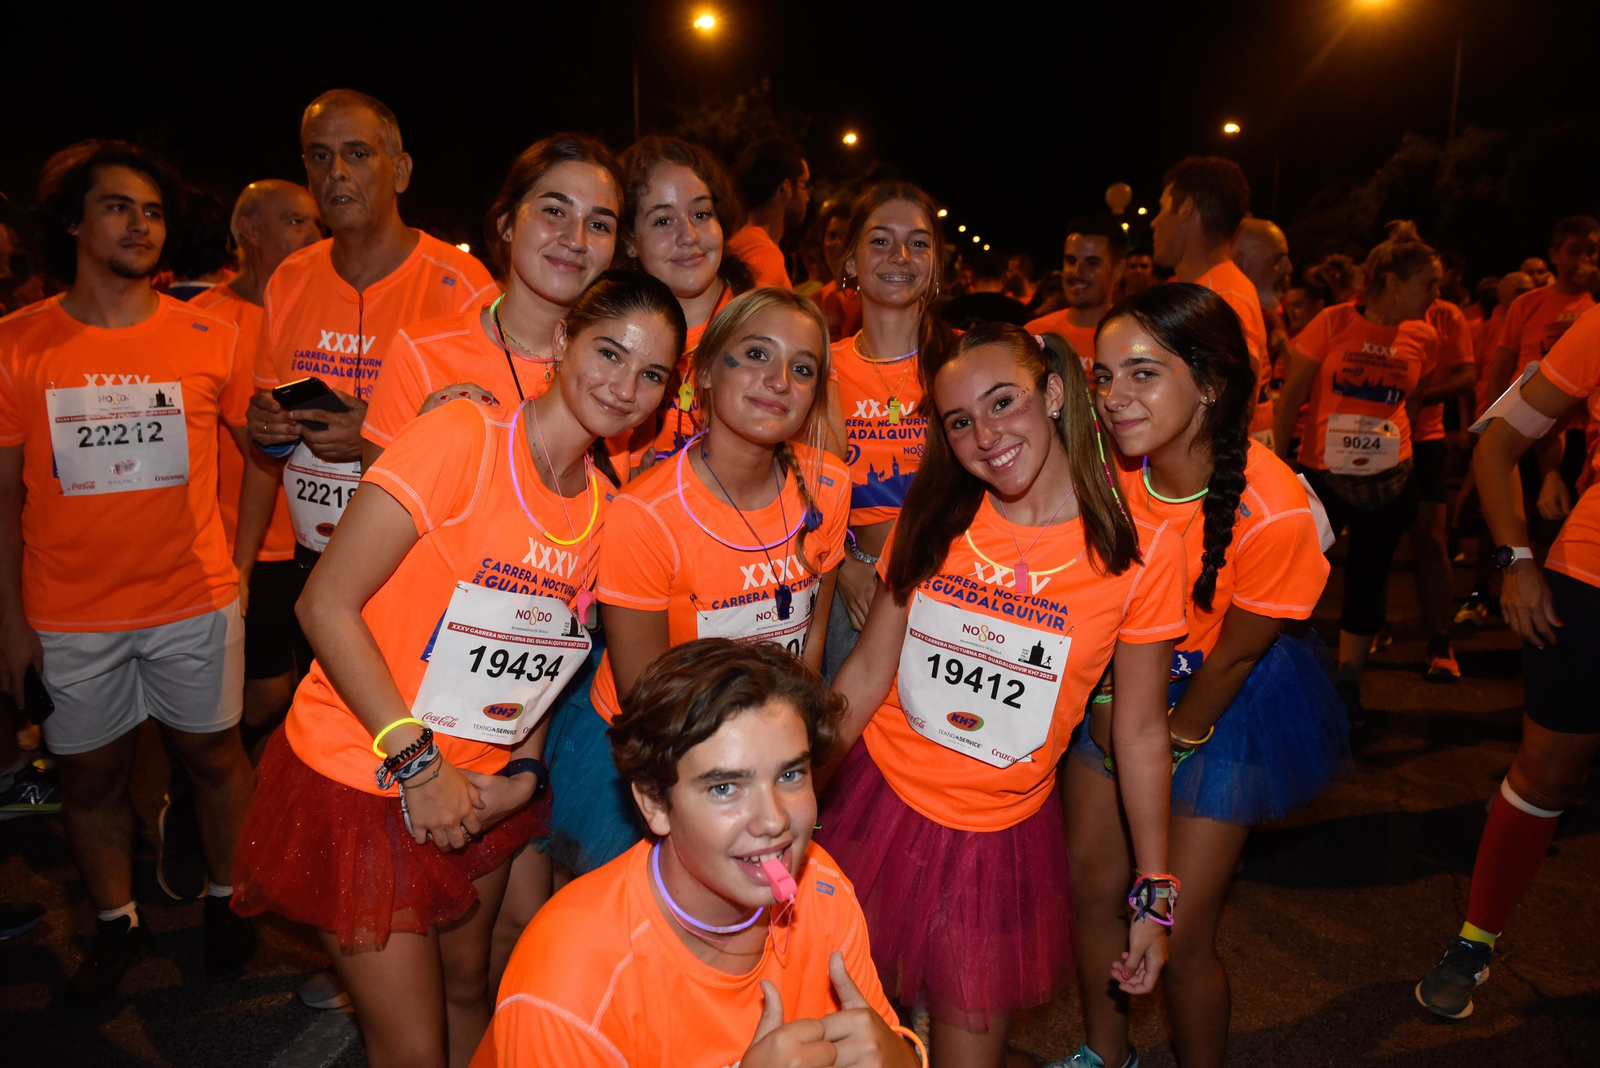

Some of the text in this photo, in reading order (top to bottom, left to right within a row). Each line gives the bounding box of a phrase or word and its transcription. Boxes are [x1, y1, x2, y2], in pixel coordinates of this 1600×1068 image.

[317, 329, 376, 355] XXXV
[1362, 342, 1397, 357] XXXV
[294, 349, 335, 363] CARRERA
[77, 421, 164, 448] 22212
[1343, 436, 1381, 450] 9024
[522, 536, 578, 579] XXXV
[472, 570, 486, 584] DEL
[482, 558, 538, 585] CARRERA
[712, 590, 770, 610] CARRERA
[932, 579, 1065, 631] GUADALQUIVIR
[993, 588, 1069, 615] NOCTURNA
[469, 645, 564, 682] 19434
[927, 653, 1025, 710] 19412
